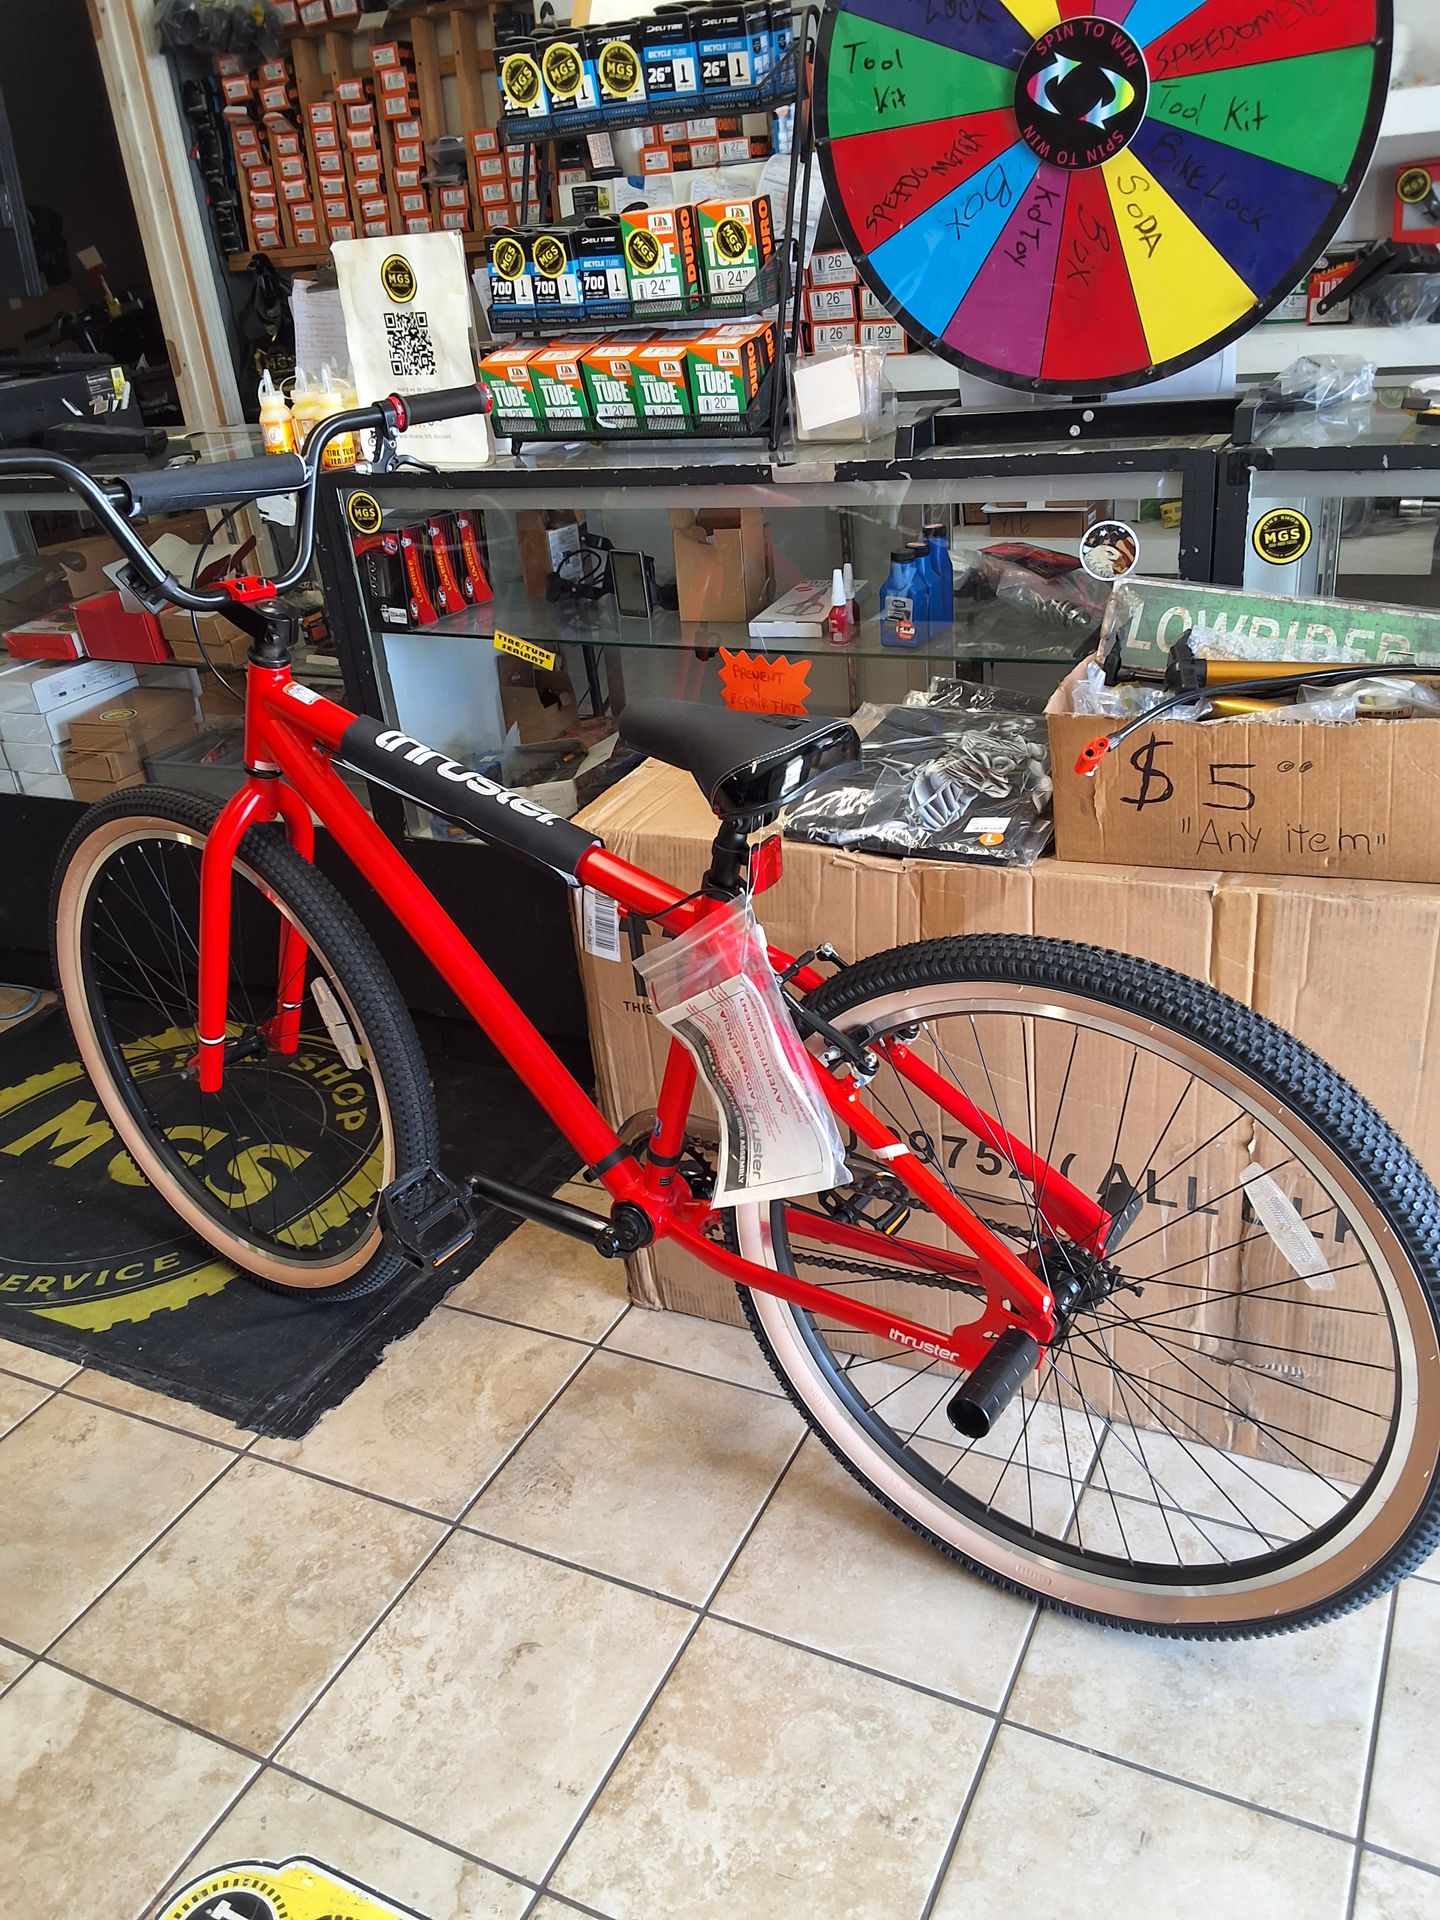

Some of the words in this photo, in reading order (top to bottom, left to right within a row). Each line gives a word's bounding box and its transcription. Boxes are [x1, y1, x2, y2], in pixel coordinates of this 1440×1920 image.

[1035, 23, 1075, 56] SPIN
[1083, 21, 1105, 37] TO
[1110, 31, 1138, 68] WIN
[549, 58, 576, 82] MGS
[606, 61, 634, 77] MGS
[647, 66, 671, 83] 26"
[702, 60, 726, 78] 26"
[511, 66, 533, 96] MGS
[1023, 124, 1050, 158] WIN
[1086, 130, 1124, 163] SPIN
[1057, 150, 1078, 166] TO
[633, 235, 655, 262] MGS
[680, 209, 697, 283] DURO
[723, 224, 743, 253] MGS
[500, 245, 516, 271] MGS
[538, 245, 559, 266] MGS
[828, 254, 847, 269] 26"
[388, 273, 411, 285] MGS
[491, 280, 512, 295] 700
[534, 281, 556, 295] 700
[583, 276, 605, 291] 700
[650, 279, 671, 294] 24"
[727, 270, 748, 286] 24"
[826, 291, 845, 305] 26"
[829, 326, 848, 340] 26"
[877, 325, 897, 339] 29"
[593, 381, 631, 403] TUBE
[641, 381, 680, 404] TUBE
[696, 371, 736, 394] TUBE
[491, 386, 530, 407] TUBE
[539, 384, 578, 406] TUBE
[714, 397, 731, 409] 20"
[611, 405, 628, 416] 20"
[354, 507, 376, 518] MGS
[1264, 528, 1301, 545] MGS
[501, 643, 545, 665] SEALANT
[732, 664, 785, 684] PREVENT
[622, 1000, 654, 1015] THIS
[288, 1054, 368, 1132] SHOP
[737, 1138, 747, 1185] ASSEMBLY
[0, 1252, 182, 1293] ERVICE
[888, 1328, 960, 1362] thruster
